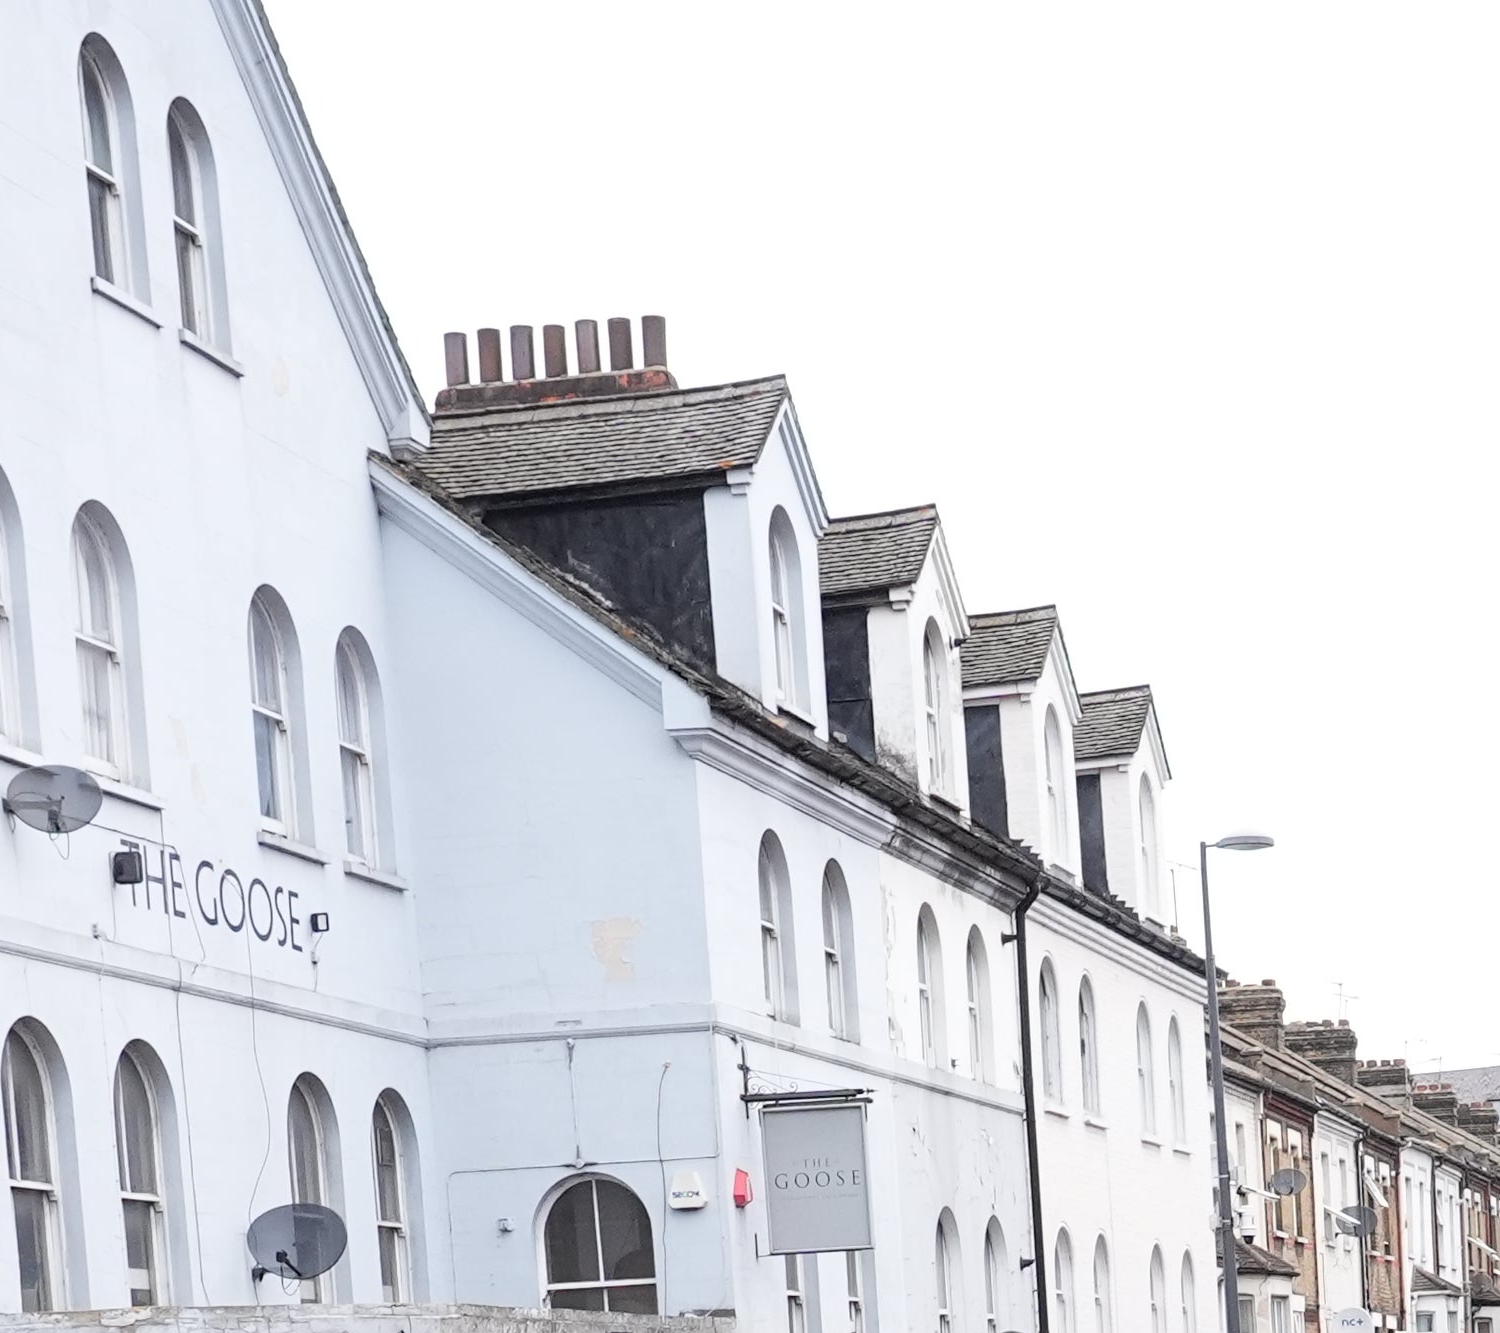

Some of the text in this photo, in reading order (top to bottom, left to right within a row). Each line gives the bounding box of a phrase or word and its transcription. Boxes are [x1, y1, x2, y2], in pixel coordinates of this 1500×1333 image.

[120, 838, 303, 953] THE GOOSE
[804, 1158, 831, 1168] THE
[774, 1169, 861, 1190] GOOSE
